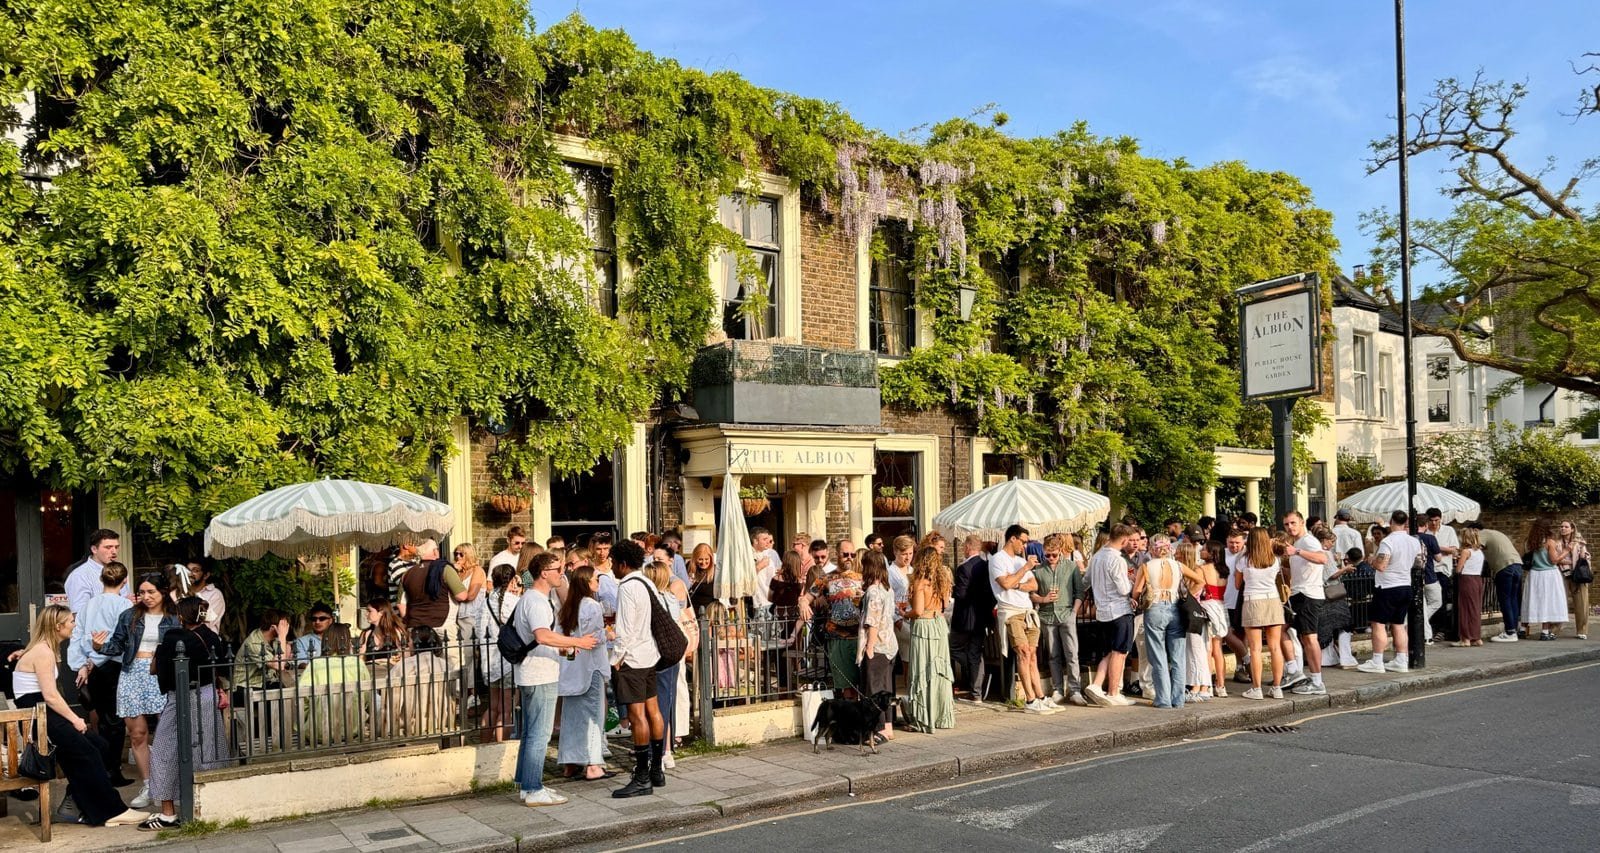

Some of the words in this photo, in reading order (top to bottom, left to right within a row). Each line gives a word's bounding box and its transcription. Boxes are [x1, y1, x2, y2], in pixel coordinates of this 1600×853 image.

[1265, 311, 1289, 322] THE
[1252, 316, 1304, 340] ALBION
[1254, 358, 1277, 367] PUBLIC
[1280, 354, 1303, 363] HOUSE
[1265, 371, 1291, 379] GARDEN
[750, 450, 785, 464] THE
[794, 450, 856, 465] ALBION
